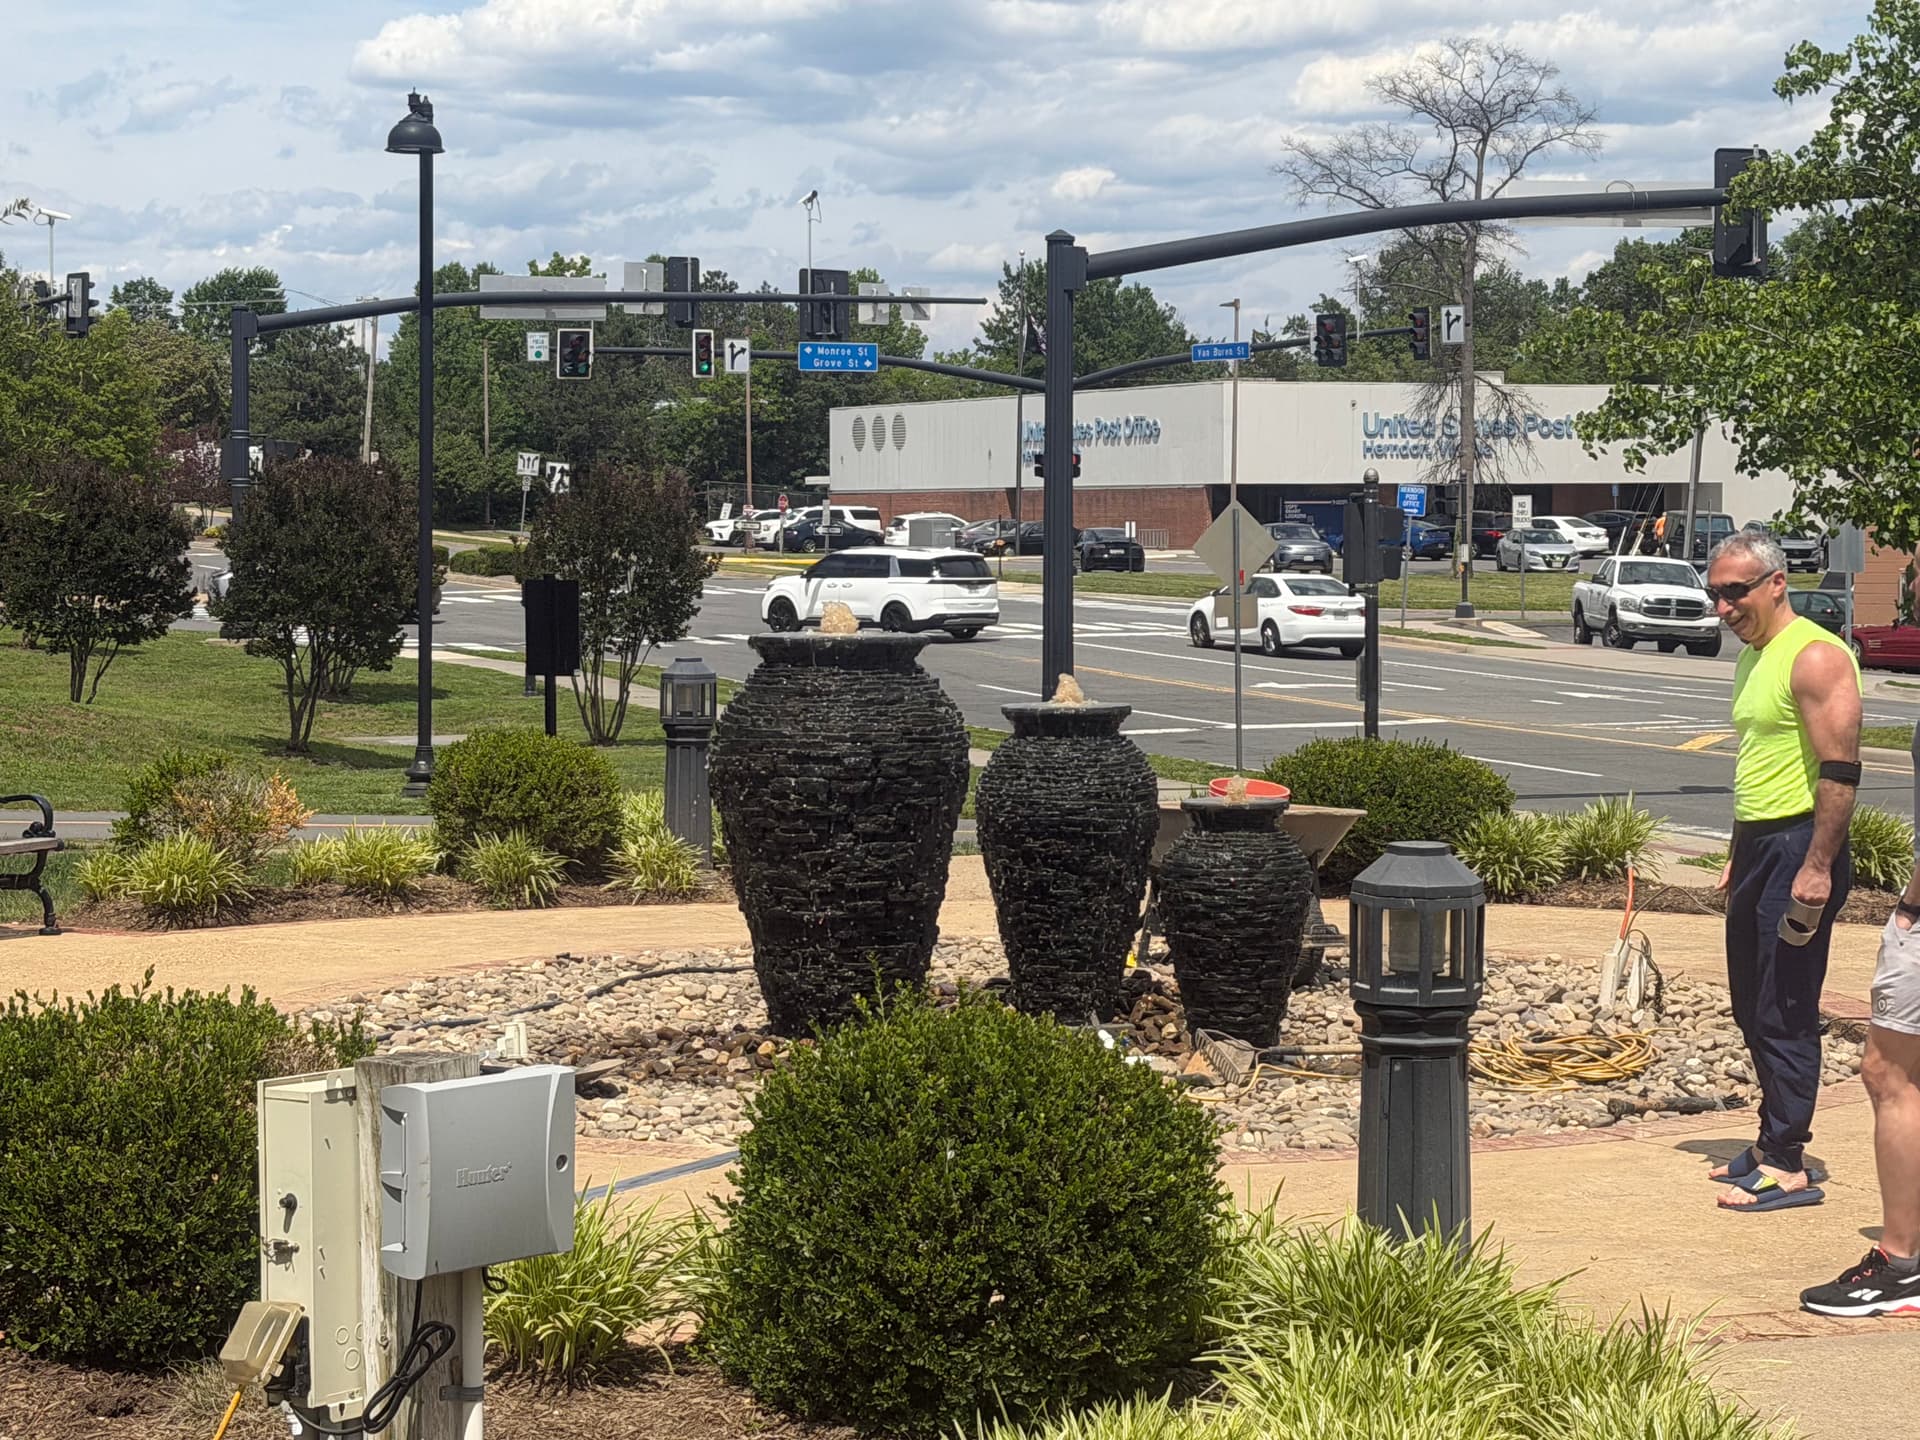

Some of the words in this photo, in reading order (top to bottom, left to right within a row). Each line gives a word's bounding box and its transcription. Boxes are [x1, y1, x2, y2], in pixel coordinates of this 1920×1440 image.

[817, 346, 851, 356] Monroe
[857, 346, 868, 357] St
[1197, 348, 1210, 358] Van
[1213, 347, 1233, 357] Buren
[1236, 346, 1245, 356] St
[813, 358, 842, 368] Grove
[848, 358, 859, 368] St
[1095, 416, 1121, 441] Post
[1124, 415, 1161, 440] Office
[1363, 412, 1436, 438] United
[1524, 414, 1573, 439] Post
[1402, 500, 1420, 508] OFFICE
[1517, 501, 1527, 509] NO
[456, 1164, 510, 1188] Hunter
